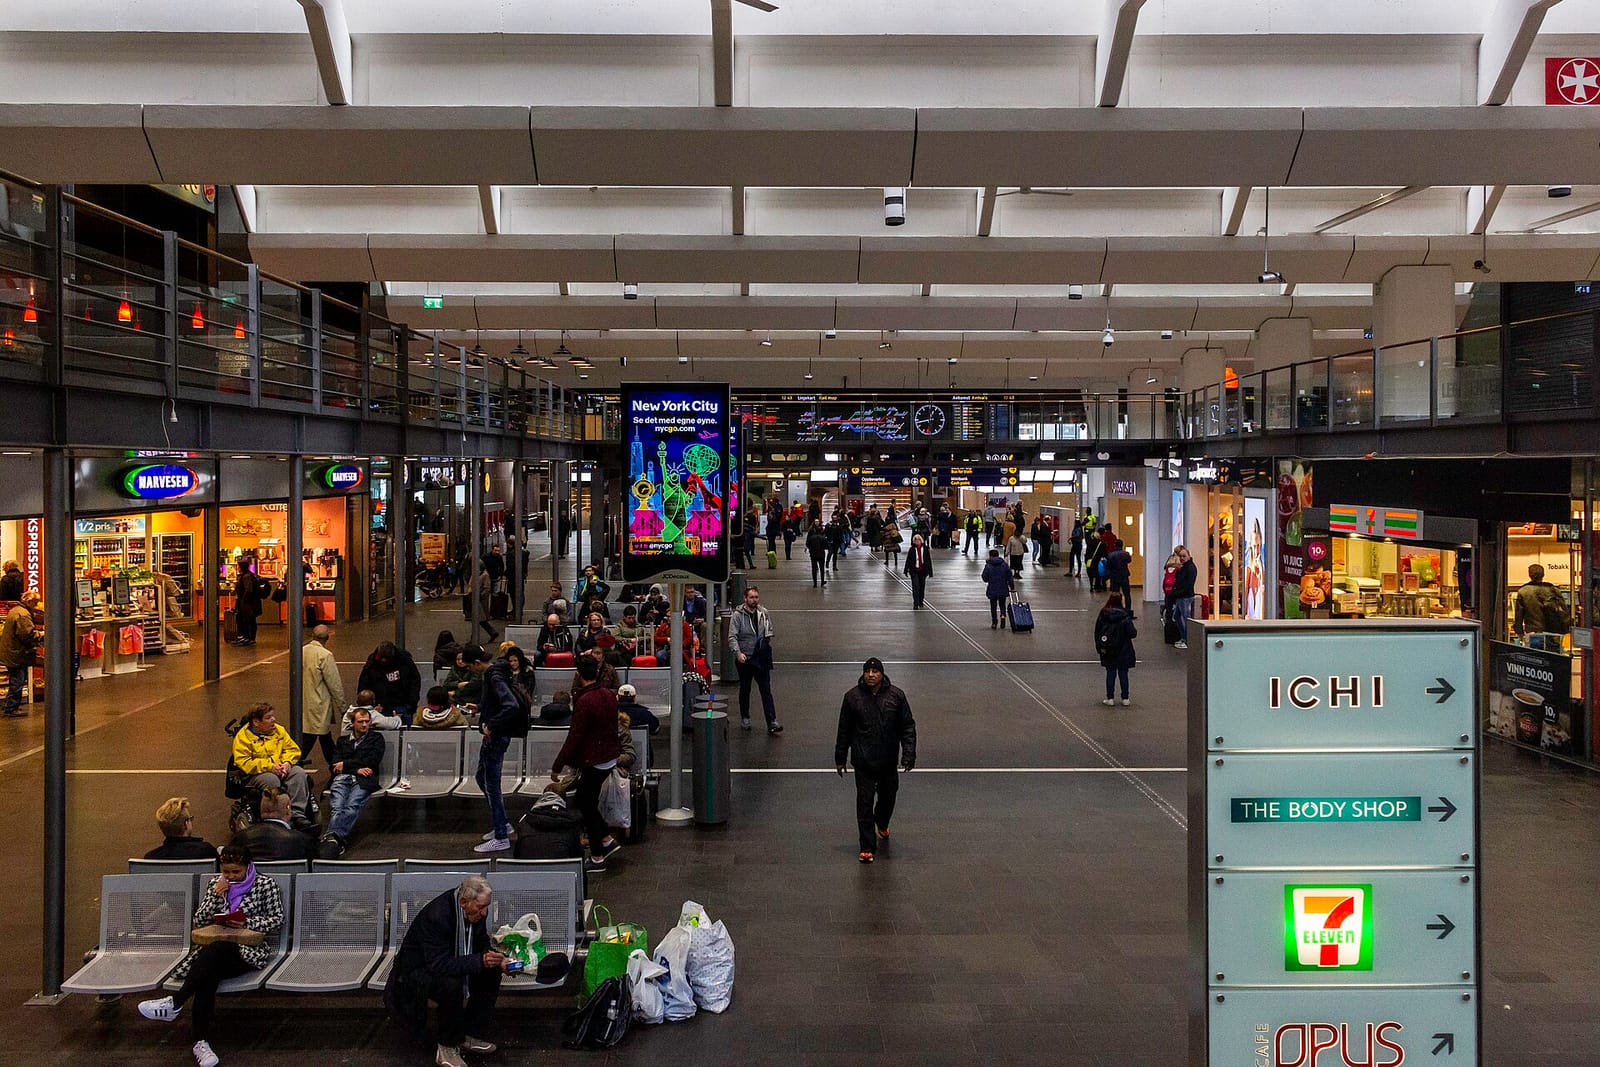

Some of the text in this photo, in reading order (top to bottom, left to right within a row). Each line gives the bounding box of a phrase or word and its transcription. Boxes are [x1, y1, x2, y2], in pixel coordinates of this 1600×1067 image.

[632, 400, 718, 413] New York City
[655, 425, 695, 433] nycgo.com
[138, 475, 188, 488] NARVESEN
[332, 472, 357, 481] NARVESEN
[79, 522, 111, 532] 1/2 pris
[649, 542, 673, 550] @nycgo
[1506, 662, 1525, 676] VINN
[1525, 667, 1553, 682] 50.000
[1269, 674, 1384, 709] ICHI
[1240, 802, 1280, 818] THE
[1289, 802, 1346, 818] BODY
[1304, 896, 1354, 966] 7
[1274, 1021, 1405, 1067] OPUS
